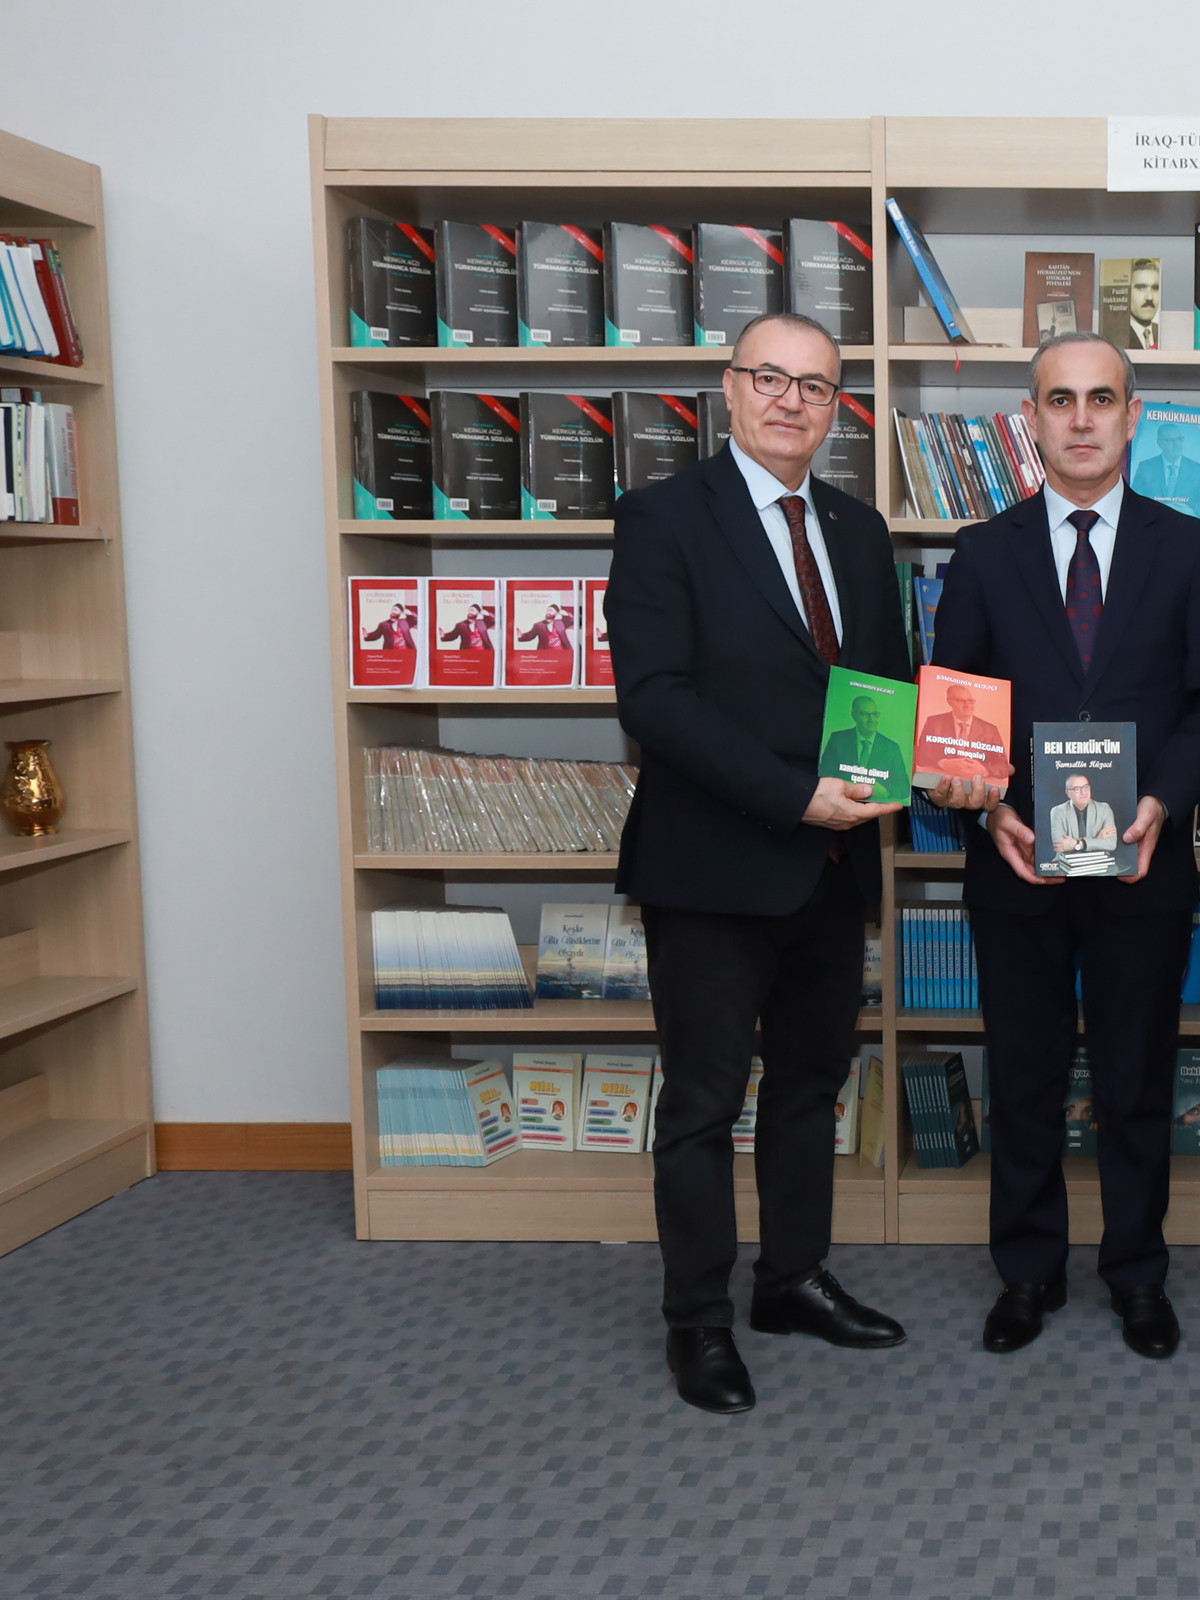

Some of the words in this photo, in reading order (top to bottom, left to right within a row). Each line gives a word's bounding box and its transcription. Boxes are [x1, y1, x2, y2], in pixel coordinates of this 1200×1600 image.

[495, 266, 517, 275] SÖZLÜ
[971, 740, 1004, 754] RÜZGARI
[1044, 741, 1063, 754] BEN
[1065, 739, 1121, 754] KERKÜK'ÜM
[543, 936, 559, 944] Bir
